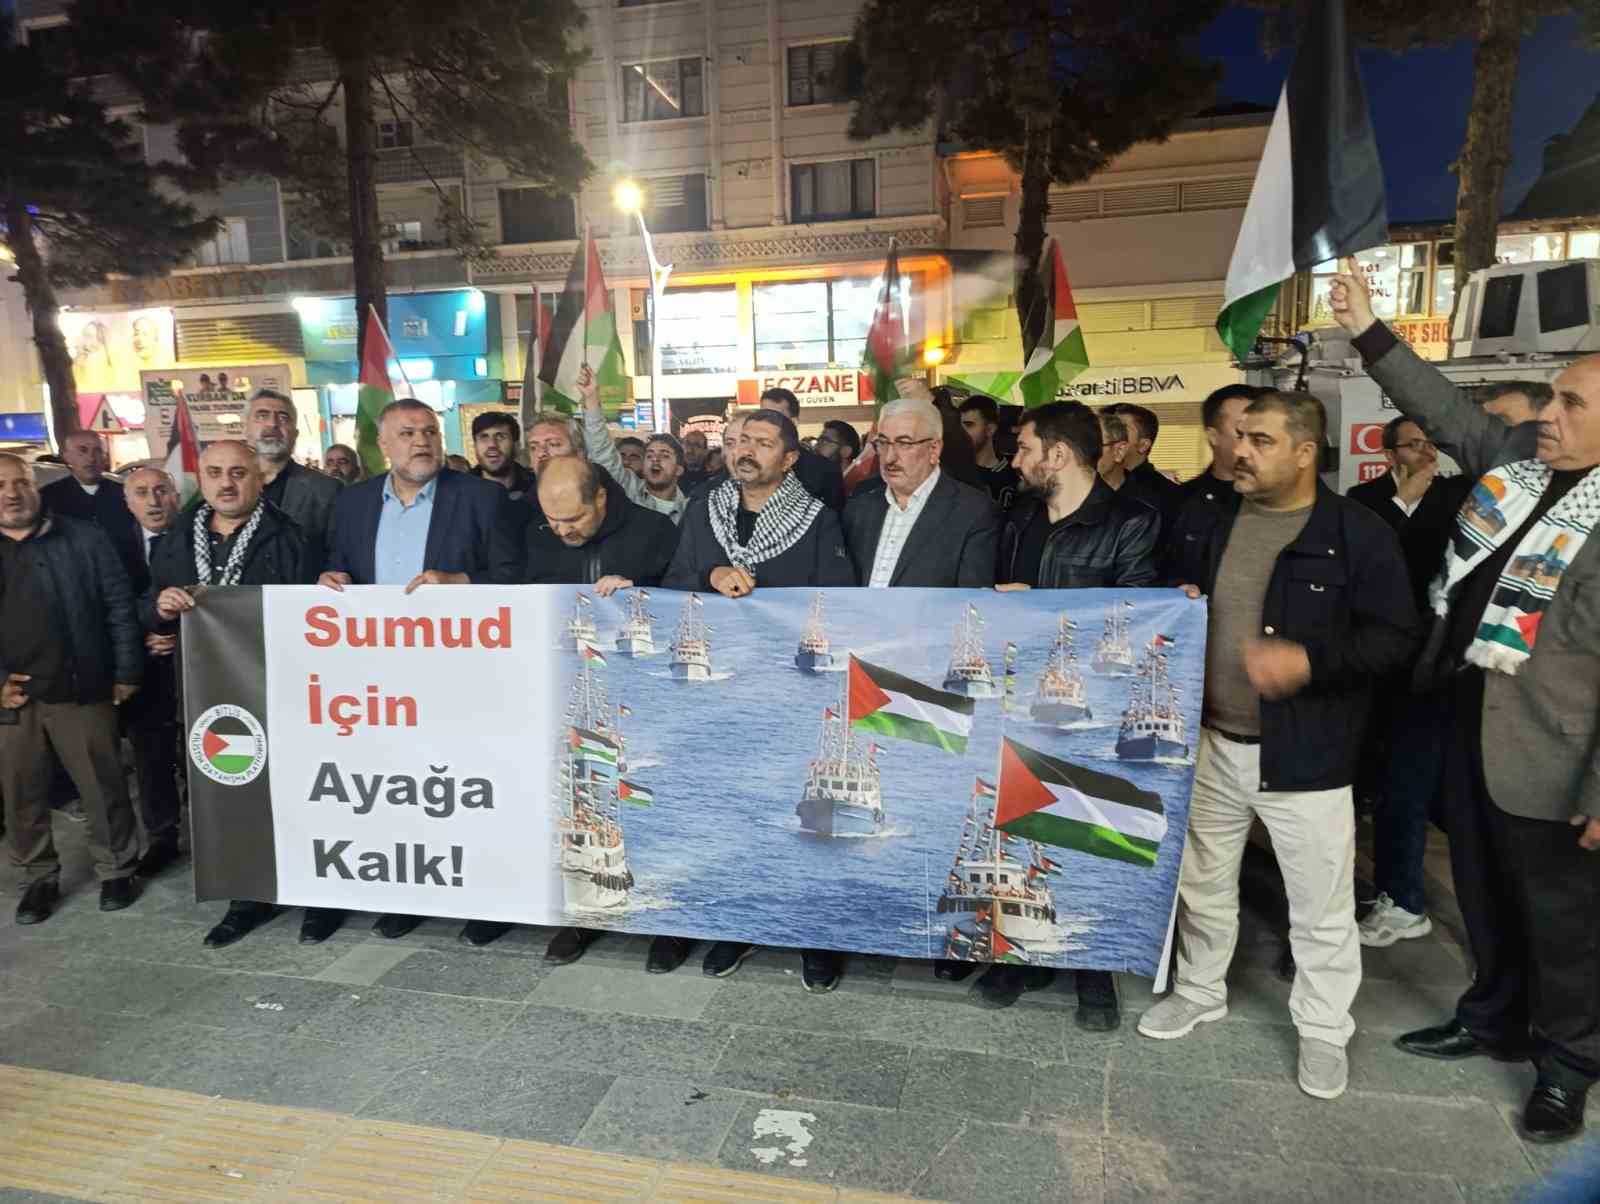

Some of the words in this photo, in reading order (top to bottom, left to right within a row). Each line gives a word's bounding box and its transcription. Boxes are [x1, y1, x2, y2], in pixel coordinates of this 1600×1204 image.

[763, 374, 854, 394] ECZANE
[1122, 373, 1185, 394] BBVA
[1363, 464, 1387, 480] 112
[304, 605, 512, 648] Sumud
[308, 674, 418, 736] İçin
[308, 762, 495, 818] Ayağa
[312, 839, 464, 887] Kalk!
